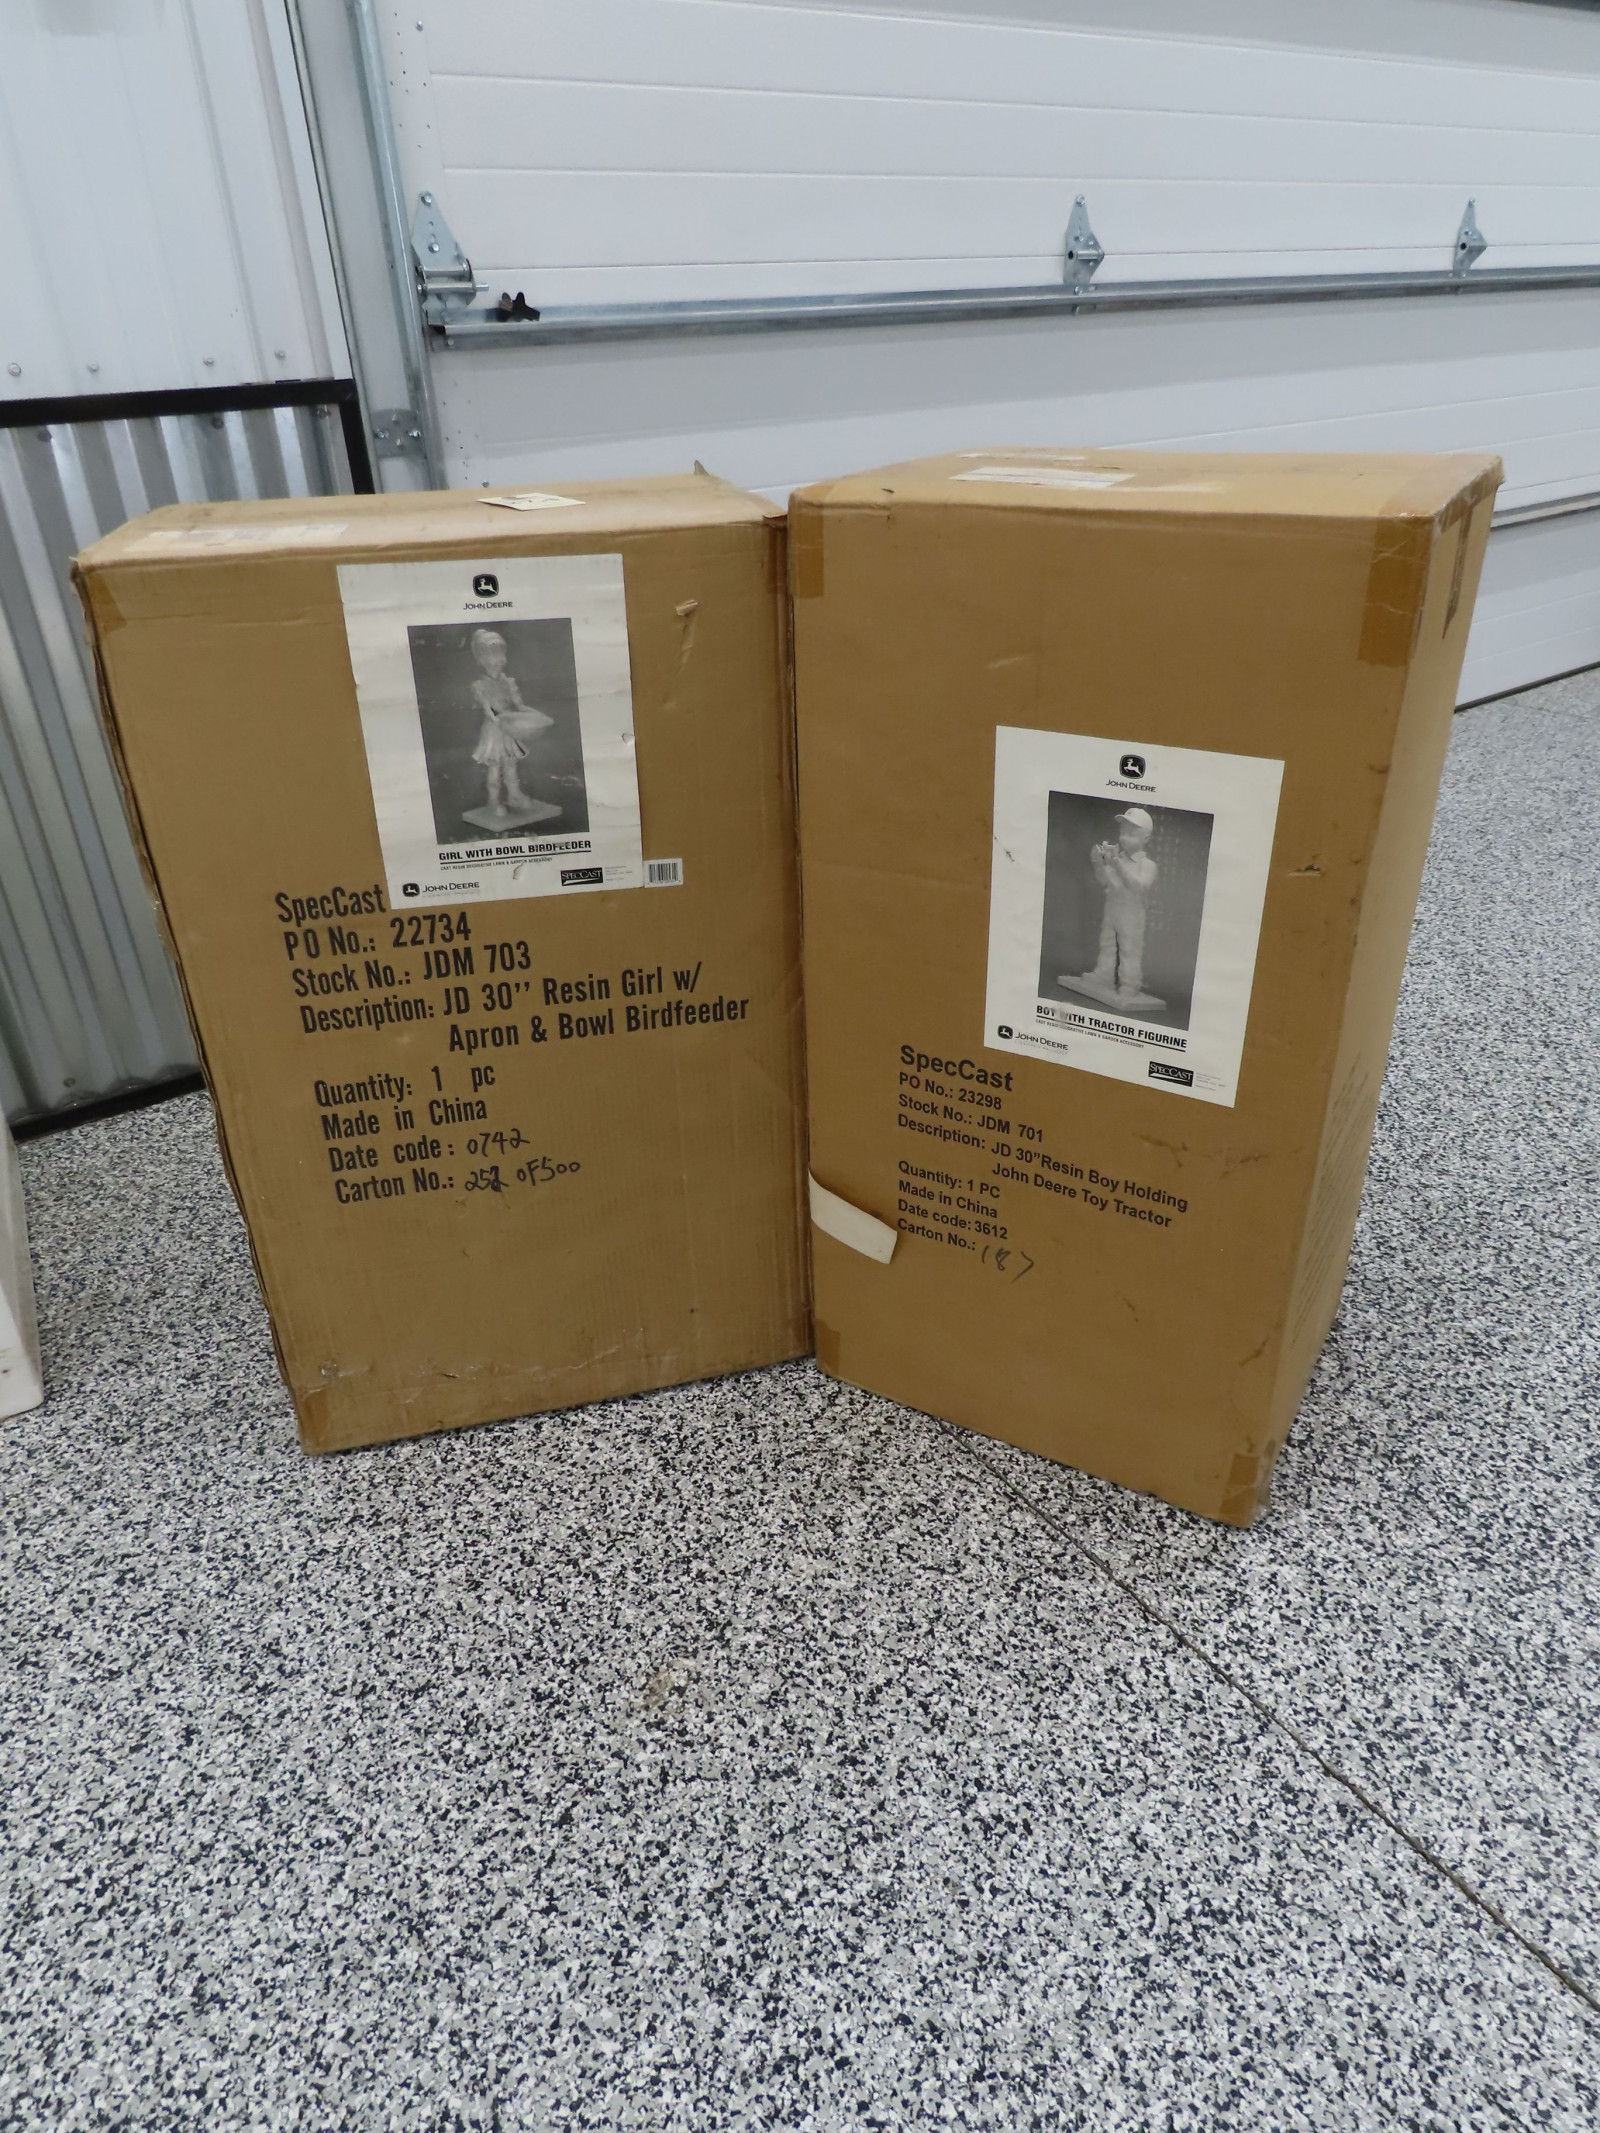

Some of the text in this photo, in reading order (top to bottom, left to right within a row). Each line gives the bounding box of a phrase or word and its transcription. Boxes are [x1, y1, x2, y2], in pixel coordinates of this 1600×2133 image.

[486, 601, 513, 609] DEERE
[1105, 779, 1156, 792] JOHN DEERE
[438, 840, 592, 861] GIRL WITH BOWL BIRDFEEDER
[275, 884, 386, 927] SpecCast
[422, 881, 480, 893] JOHN DEERE
[284, 912, 471, 961] PO No.: 22734
[292, 940, 531, 997] Stock No.: JDM 703
[300, 995, 435, 1034] Description:
[443, 986, 470, 1016] JD
[543, 974, 610, 1006] Resin
[621, 966, 663, 997] Girl
[672, 961, 702, 993] w/
[449, 995, 750, 1055] Apron & Bowl Birdfeeder
[1015, 1032, 1038, 1043] JOHN
[1040, 1038, 1069, 1051] DEERE
[1036, 1005, 1056, 1017] BOY
[1088, 1017, 1135, 1036] TRACTOR
[1137, 1029, 1187, 1049] FIGURINE
[314, 1063, 496, 1107] Quantity: 1 pc
[900, 1045, 1013, 1092] SpecCast
[1149, 1063, 1193, 1081] SPECCAST
[900, 1072, 1002, 1110] PO No.: 23298
[321, 1098, 488, 1140] Made in China
[899, 1094, 1043, 1142] Stock No.: JDM 701
[328, 1144, 379, 1173] Date
[467, 1128, 530, 1157] 0742
[898, 1113, 985, 1149] Description:
[991, 1141, 1011, 1157] JD
[1089, 1169, 1119, 1194] Boy
[1124, 1179, 1188, 1213] Holding
[335, 1164, 454, 1204] Carton No.:
[898, 1160, 1000, 1199] Quantity: 1 PC
[899, 1179, 998, 1219] Made in China
[992, 1163, 1172, 1228] John Deere Toy Tractor
[898, 1198, 1008, 1240] Date code: 3612
[898, 1218, 976, 1251] Carton No.:
